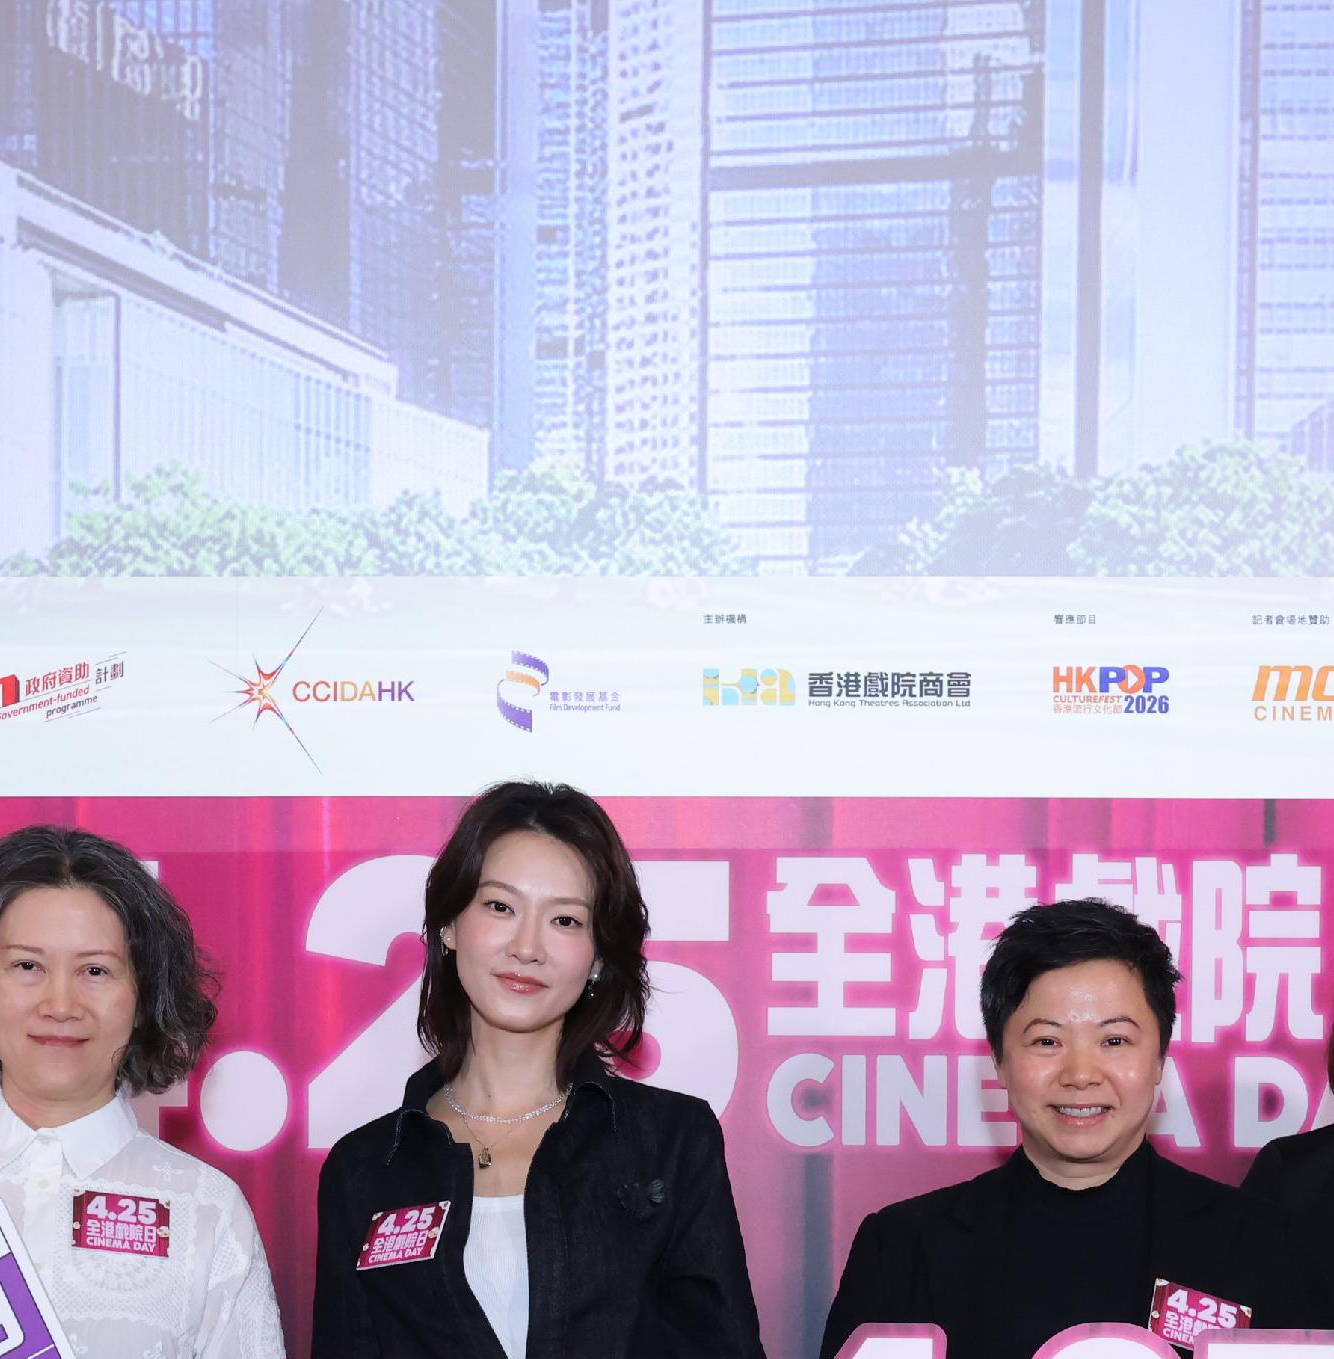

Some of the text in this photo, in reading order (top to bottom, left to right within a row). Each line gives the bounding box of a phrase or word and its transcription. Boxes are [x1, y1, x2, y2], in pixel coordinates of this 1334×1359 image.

[703, 614, 747, 624] 主辦機構
[25, 661, 124, 696] 政府資助 計劃
[808, 671, 971, 698] 香港戲院商會
[293, 681, 415, 702] CCIDAHK
[808, 699, 971, 708] Hong Kong Theatres Association Ltd
[46, 695, 98, 719] programme
[1053, 695, 1169, 713] CULTUREFEST 2026
[767, 1053, 1202, 1148] CINEA
[87, 1195, 157, 1225] 4.25
[378, 1207, 436, 1235] 4.25
[86, 1219, 157, 1243] 全港戲院日
[371, 1230, 428, 1254] 全港戲院日
[86, 1236, 156, 1253] CINEMA DAY
[369, 1246, 424, 1263] CINEMA DAY
[1167, 1289, 1238, 1329] 4.25
[1163, 1328, 1195, 1344] CINE
